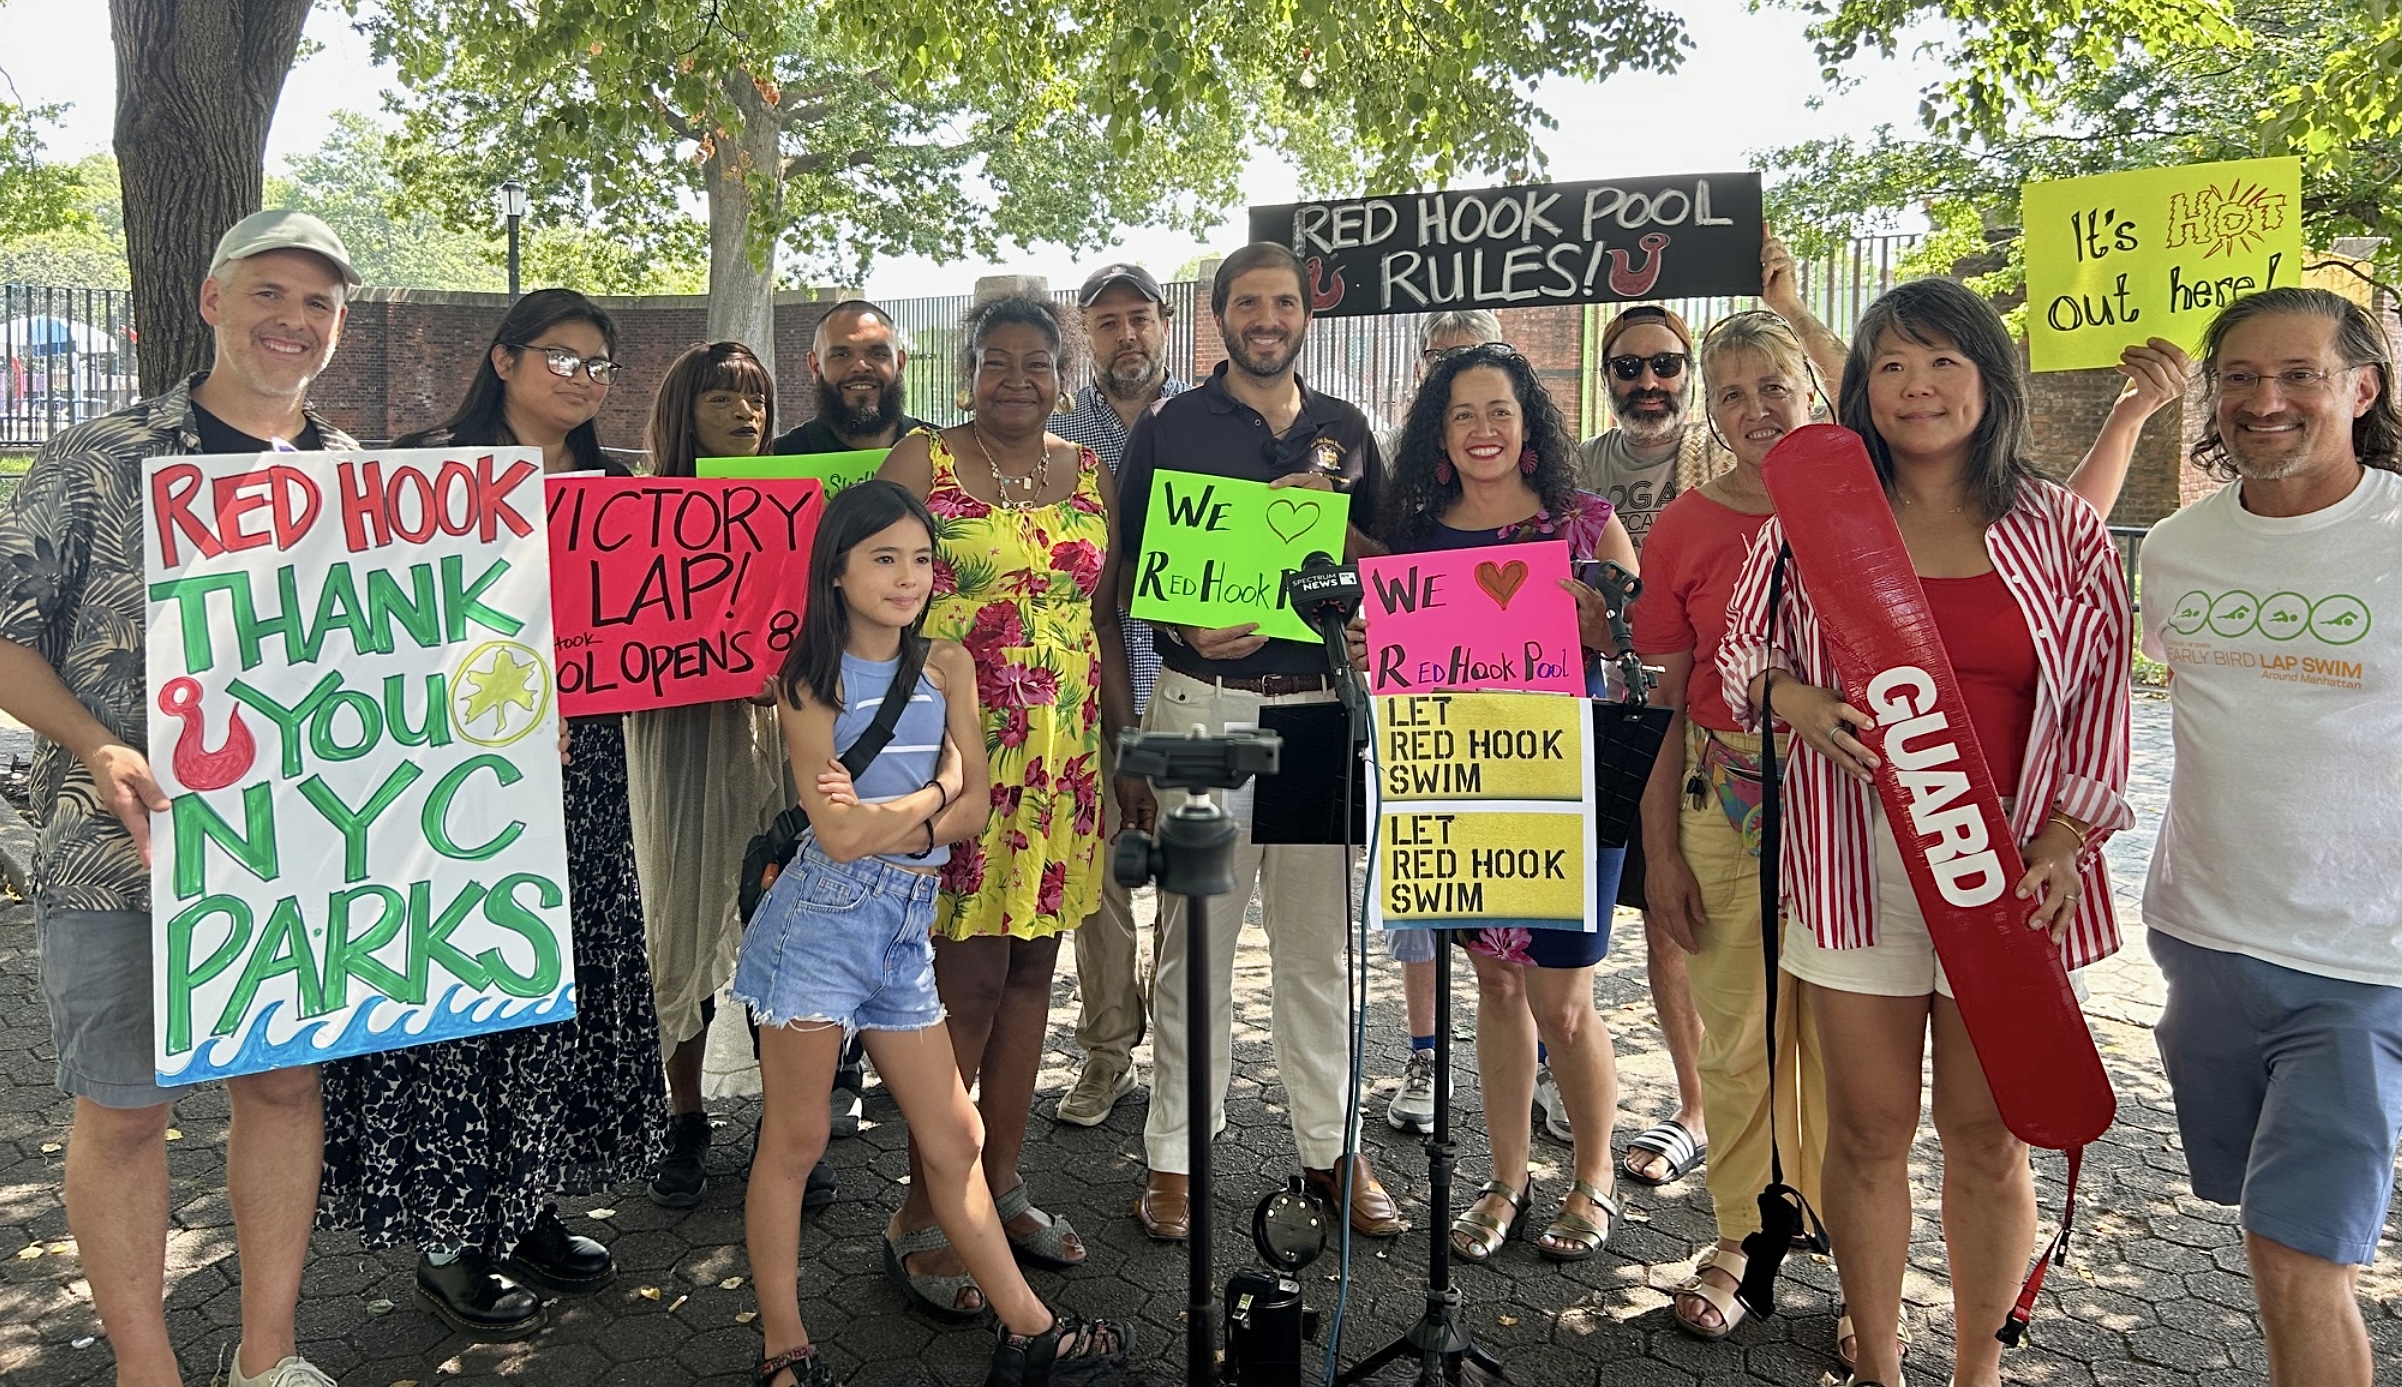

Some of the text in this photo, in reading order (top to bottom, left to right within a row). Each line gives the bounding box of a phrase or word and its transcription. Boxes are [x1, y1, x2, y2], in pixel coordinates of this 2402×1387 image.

[1293, 179, 1734, 257] RED HOOK POOL
[2071, 190, 2287, 262] It's HOT
[1380, 241, 1605, 310] RULES!
[2048, 273, 2139, 331] out
[151, 455, 540, 568] RED HOOK
[1597, 480, 1677, 511] OGA
[591, 552, 751, 628] LAP!
[1292, 573, 1337, 587] SPECTRUM
[1303, 579, 1338, 591] NEWS
[149, 555, 526, 674] THANK
[557, 650, 618, 695] OL
[621, 629, 755, 697] OPENS
[2168, 647, 2363, 680] EARLY BIRD LAP SWIM
[2262, 670, 2362, 689] Around Manhattan
[1389, 697, 1452, 727] LET
[1391, 729, 1563, 761] RED HOOK
[1389, 763, 1481, 794] SWIM
[1866, 666, 2006, 907] GUARD
[171, 754, 527, 900] NYC
[1391, 815, 1455, 845] LET
[1392, 848, 1566, 879] RED HOOK
[1391, 883, 1483, 913] SWIM
[165, 873, 563, 1056] PARKS
